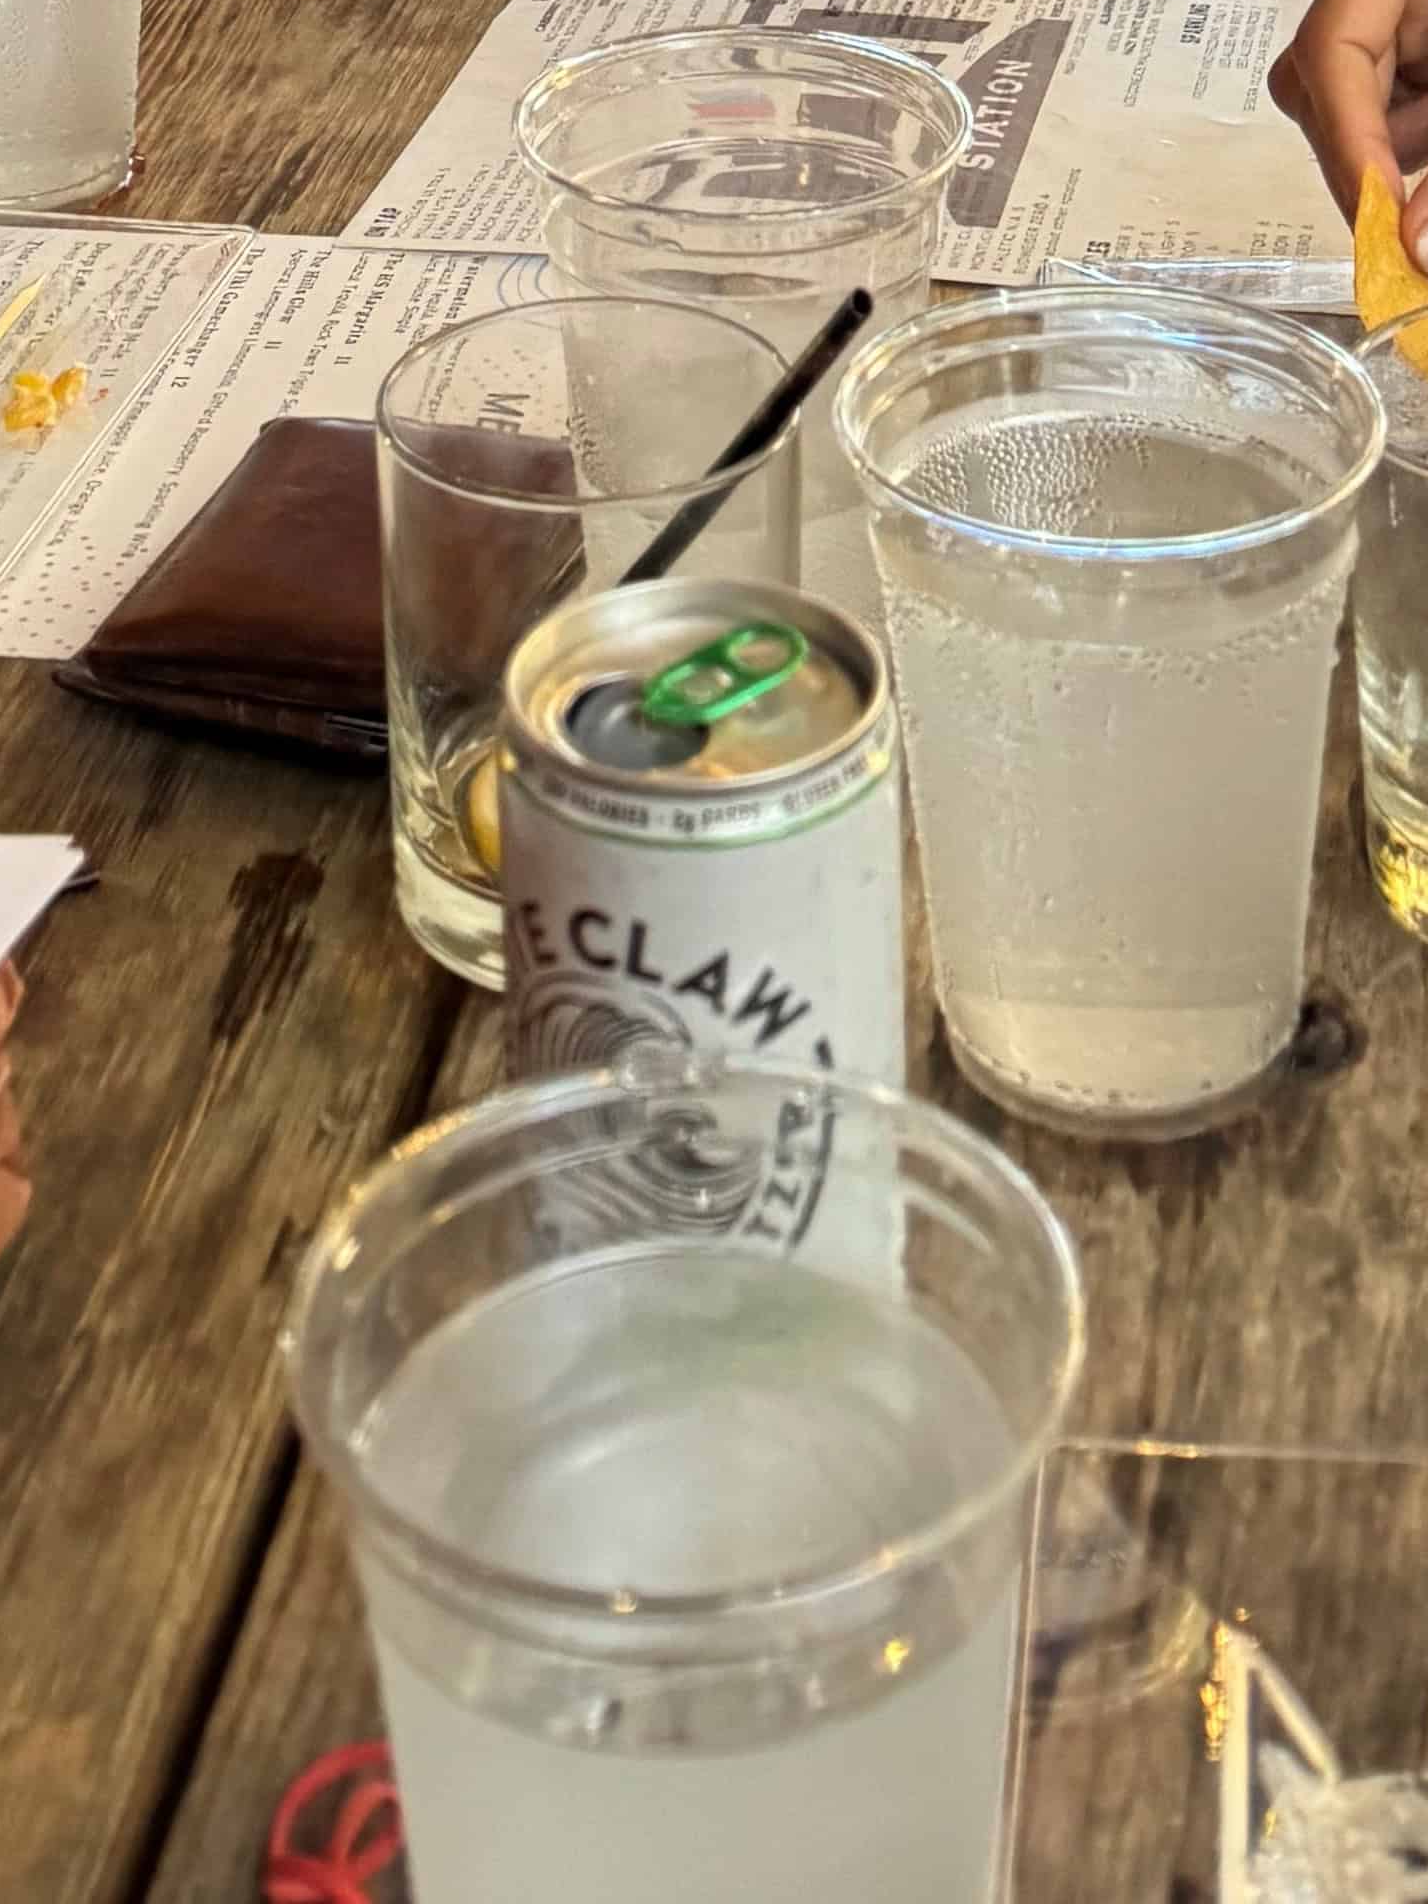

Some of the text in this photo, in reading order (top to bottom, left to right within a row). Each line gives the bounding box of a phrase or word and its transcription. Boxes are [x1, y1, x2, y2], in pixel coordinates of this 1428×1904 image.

[955, 59, 1033, 169] STATION
[240, 247, 266, 265] The
[306, 249, 332, 268] The
[380, 252, 407, 270] The
[292, 270, 322, 294] Hills
[371, 273, 395, 287] HS
[276, 296, 307, 324] Glow
[338, 289, 388, 345] Margarita
[178, 292, 239, 367] Gamechanger
[567, 908, 812, 1047] CLAW
